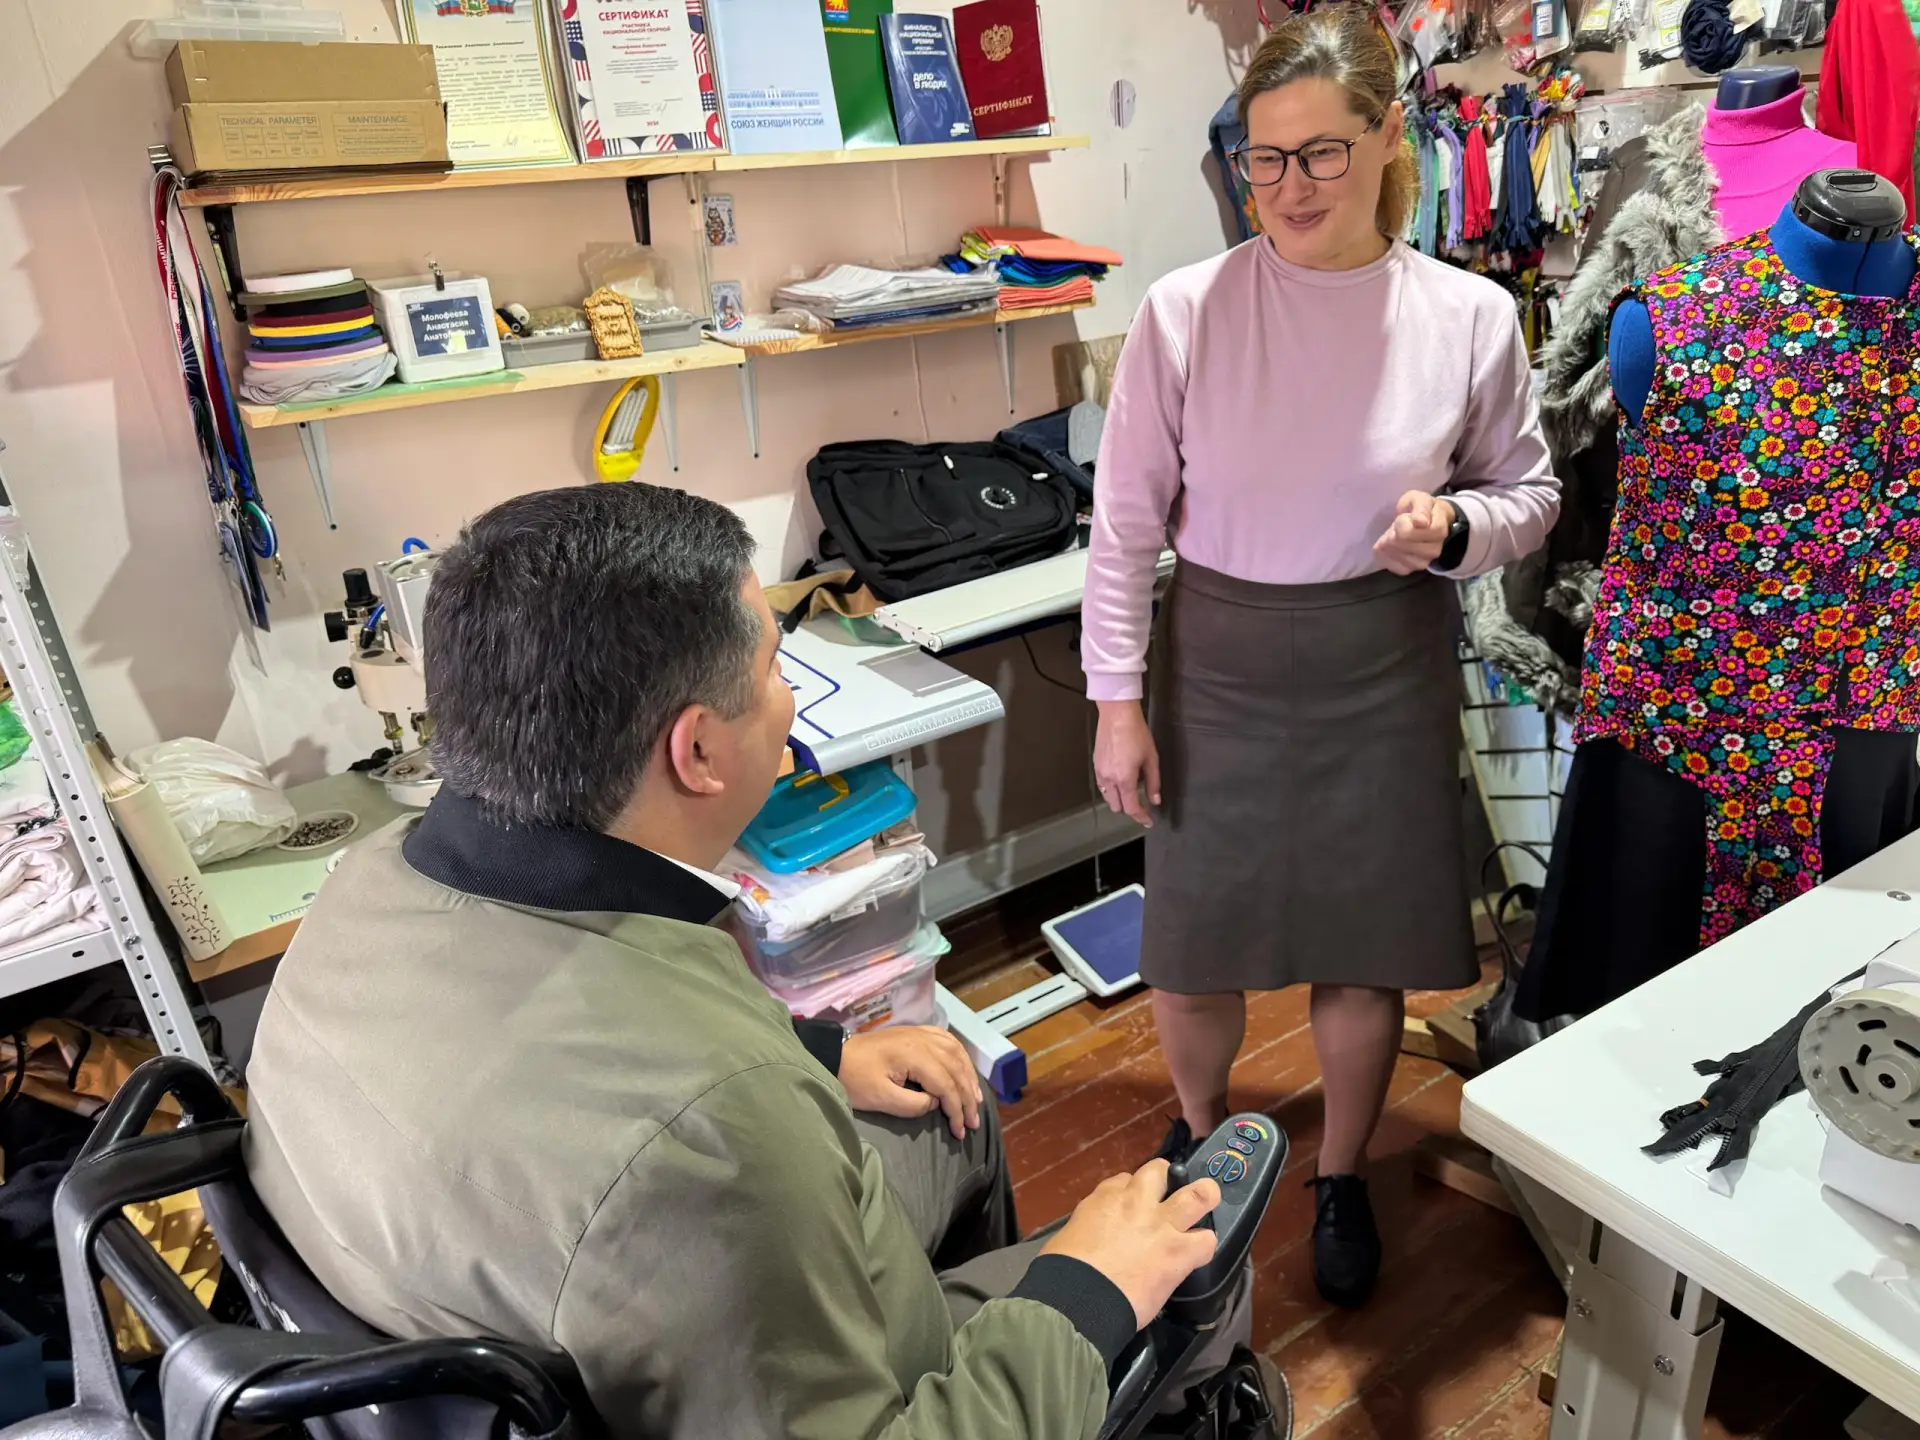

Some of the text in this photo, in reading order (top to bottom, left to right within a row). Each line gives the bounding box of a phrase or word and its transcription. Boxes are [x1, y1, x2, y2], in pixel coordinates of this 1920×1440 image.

[598, 9, 669, 21] СЕРТИФИКАТ
[913, 72, 934, 82] ДЕЛО
[914, 80, 947, 90] В ЛЮДЯХ
[973, 95, 1033, 117] СЕРТИФИКАТ
[221, 116, 317, 126] TECHNICAL PARAMETER
[347, 115, 409, 124] MAINTENANCE
[731, 118, 824, 129] СОЮЗ ЖЕНЩИН РОССИИ
[421, 310, 469, 322] Молофеева
[426, 320, 469, 331] Анастасия
